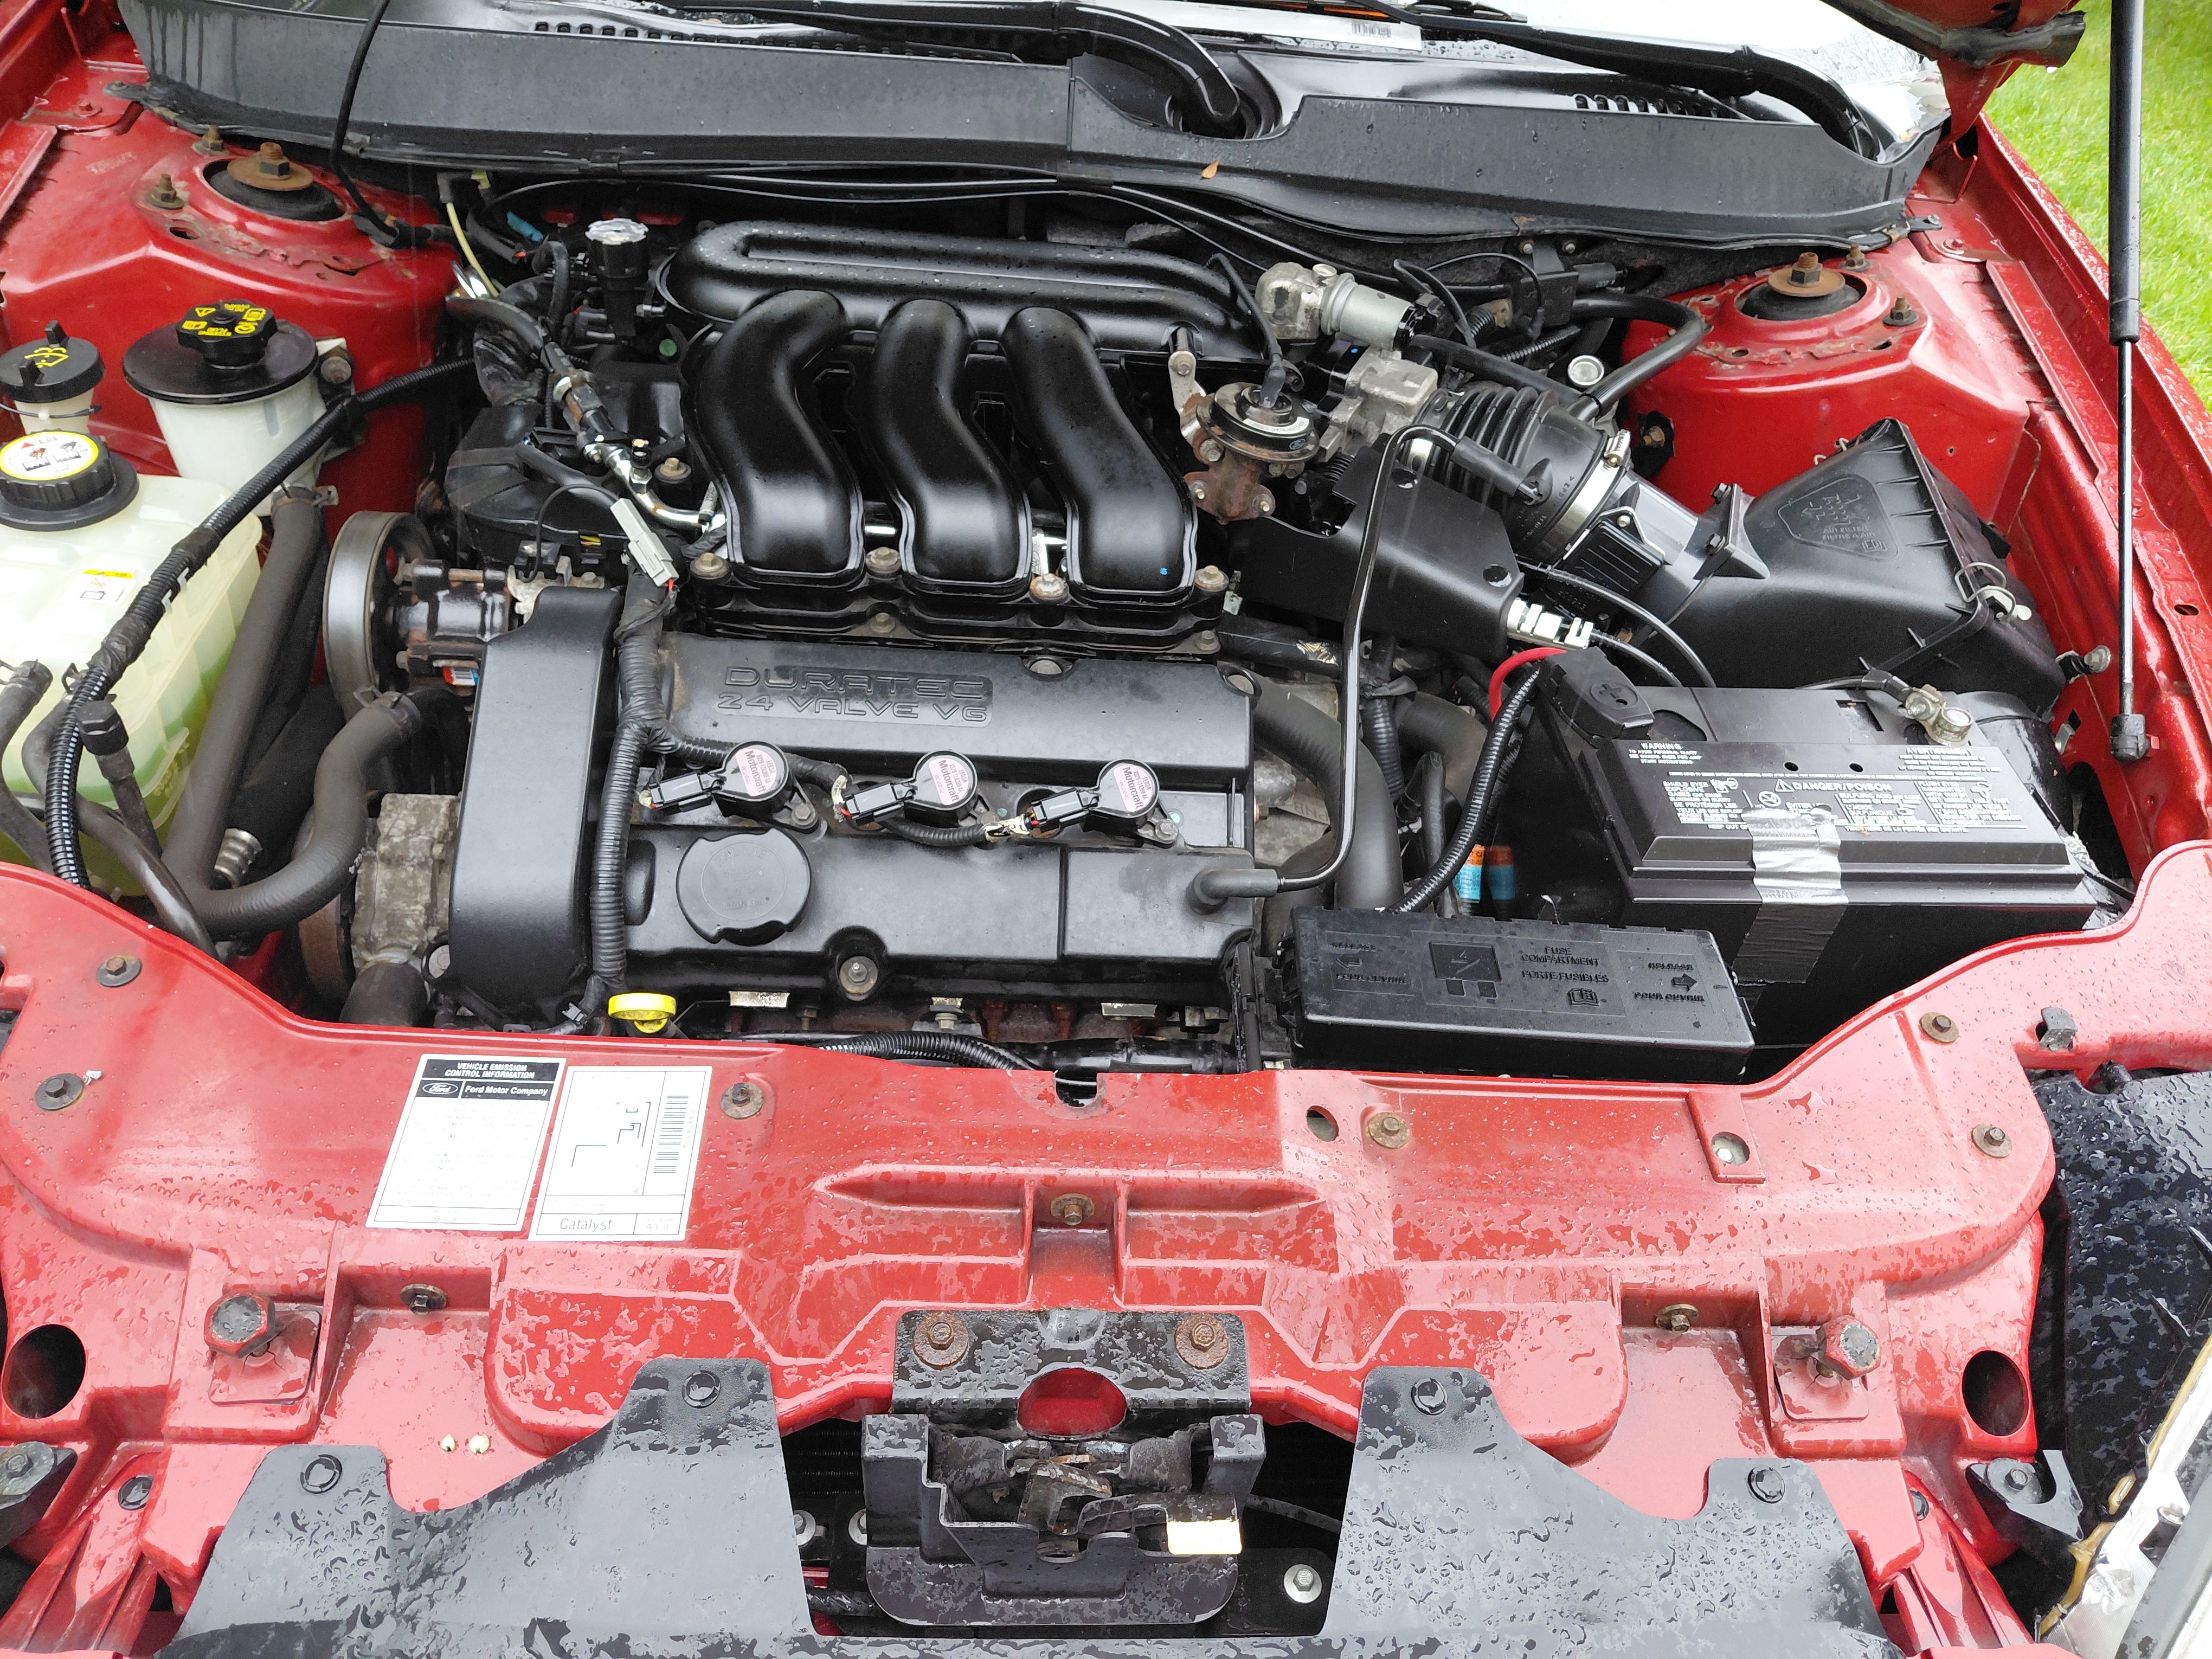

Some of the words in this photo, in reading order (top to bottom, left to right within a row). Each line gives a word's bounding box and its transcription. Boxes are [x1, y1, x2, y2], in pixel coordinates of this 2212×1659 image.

[725, 666, 984, 699] DURATEC
[718, 693, 774, 711] 24
[787, 696, 919, 718] VALVE
[932, 703, 988, 722] V6
[745, 750, 767, 793] Motorcraft
[938, 760, 960, 802] Motorcraft
[1122, 766, 1144, 809] Motorcraft
[713, 845, 768, 865] ENGINE
[1545, 946, 1572, 955] FUSE
[1521, 954, 1599, 967] COMPARTMENT
[1648, 962, 1694, 972] RELEASE
[1634, 992, 1664, 1000] POUR
[445, 1069, 480, 1077] CONTROL
[481, 1070, 535, 1079] INFORMATION
[457, 1062, 488, 1070] VEHICLE
[490, 1063, 528, 1072] EMISSION
[465, 1085, 484, 1094] Ford
[485, 1086, 509, 1094] Motor
[510, 1086, 549, 1097] Company
[560, 1218, 612, 1233] Catalyst
